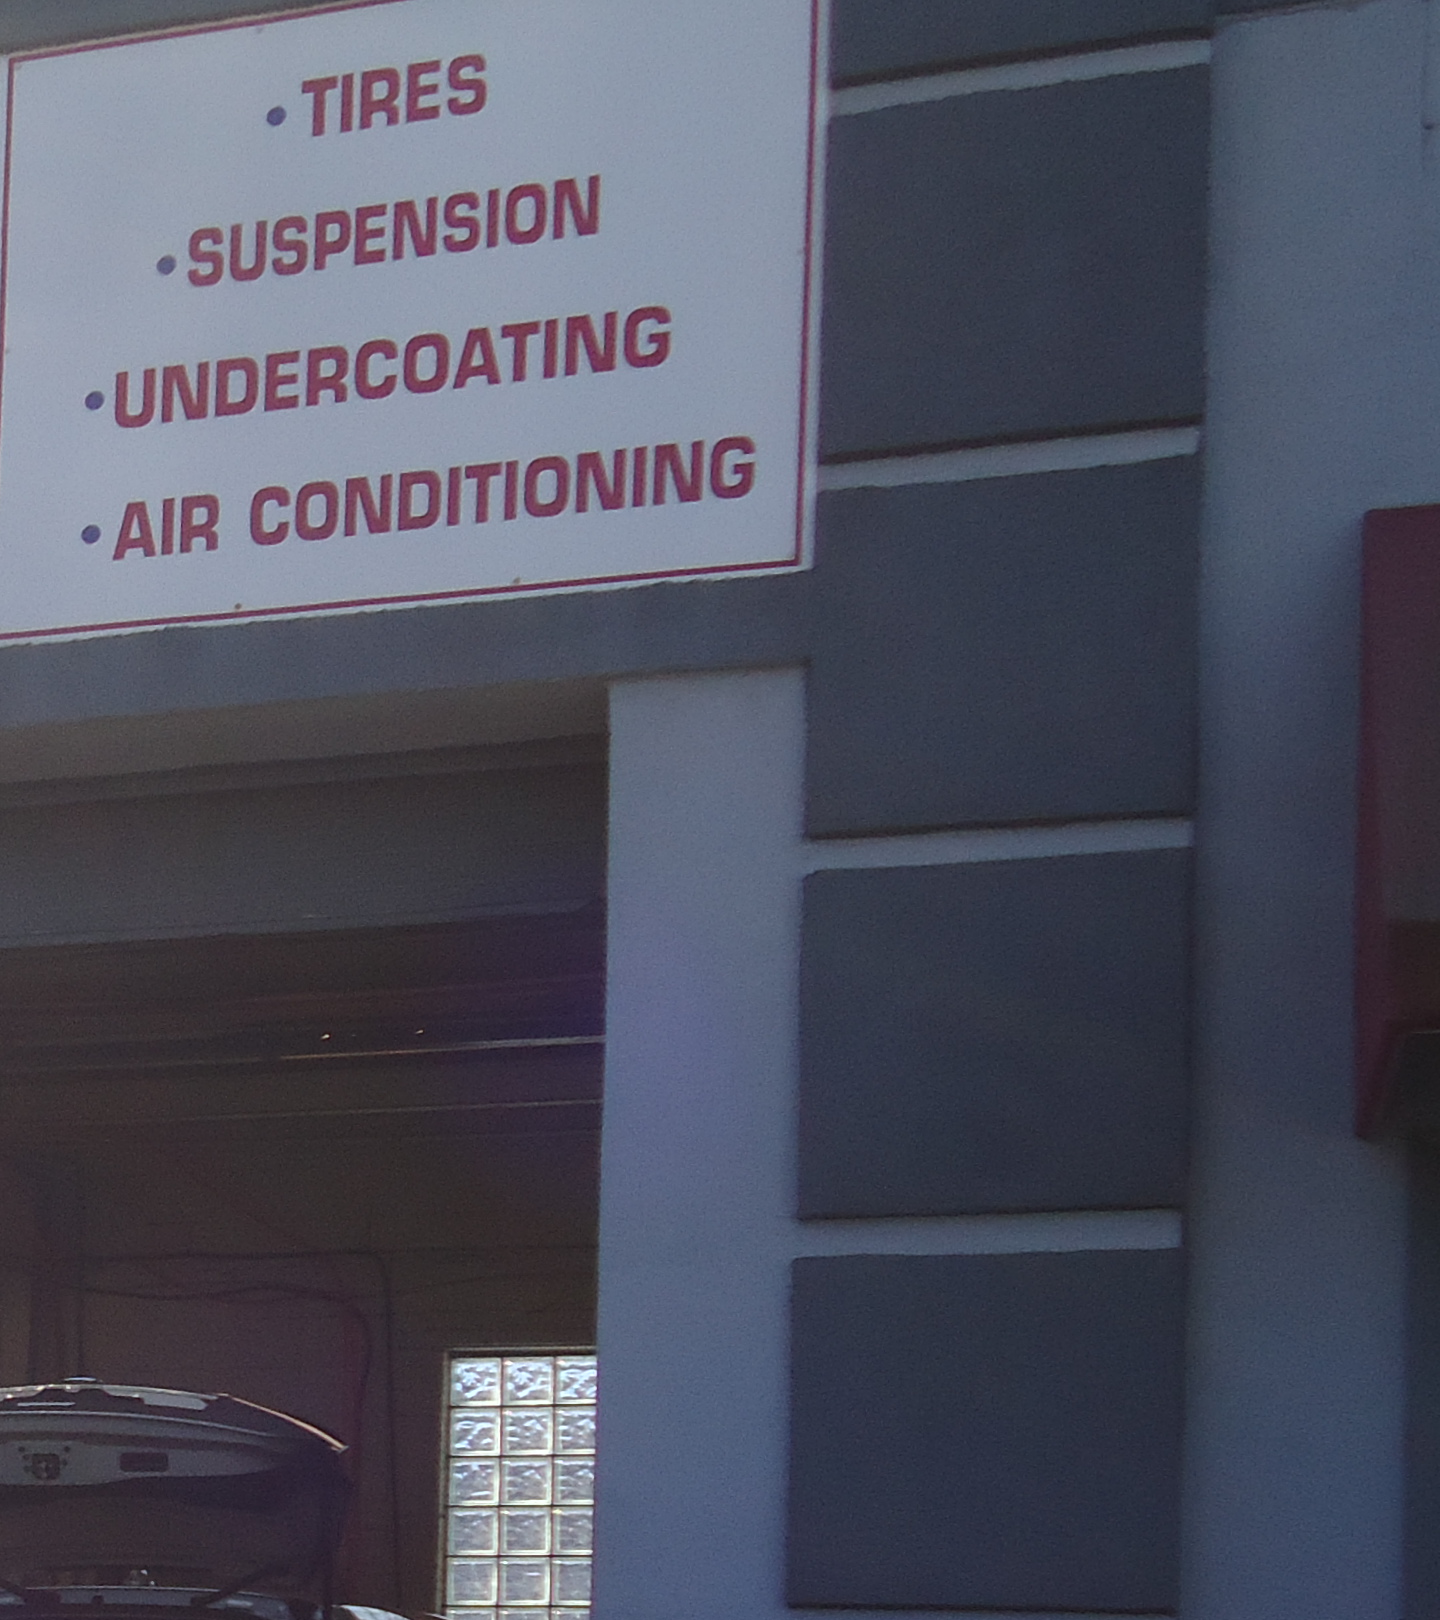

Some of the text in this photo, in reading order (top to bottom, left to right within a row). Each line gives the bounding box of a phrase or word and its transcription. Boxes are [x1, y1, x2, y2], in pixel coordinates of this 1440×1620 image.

[301, 53, 488, 137] TIRES
[186, 174, 602, 287] SUSPENSION
[112, 305, 672, 428] UNDERCOATING
[112, 435, 756, 561] AIR CONDITIONING
